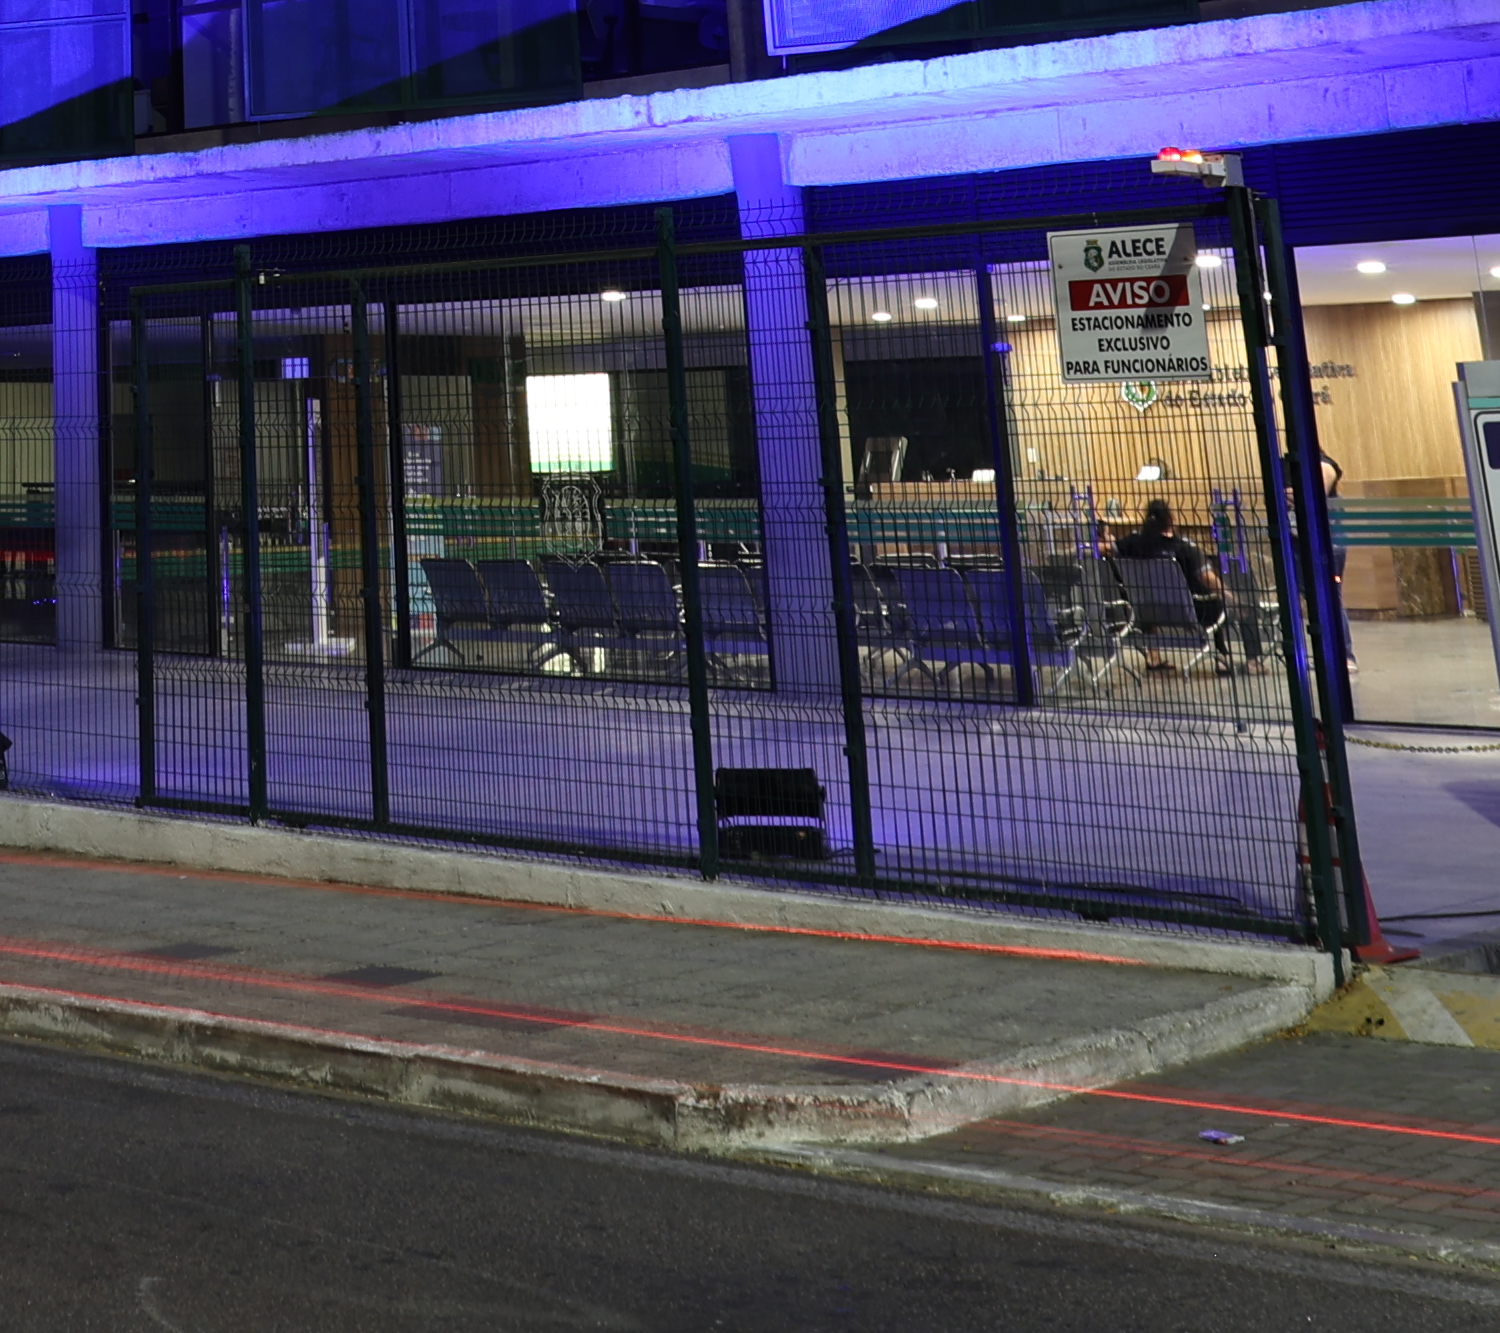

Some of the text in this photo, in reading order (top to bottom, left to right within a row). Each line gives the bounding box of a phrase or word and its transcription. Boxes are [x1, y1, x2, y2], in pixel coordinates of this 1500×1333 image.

[1108, 237, 1166, 258] ALECE
[1088, 280, 1170, 307] AVISO
[1071, 312, 1192, 331] ESTACIONAMENTO
[1098, 335, 1170, 352] EXCLUSIVO
[1066, 360, 1100, 375] PARA
[1104, 354, 1208, 374] FUNCIONÁRIOS
